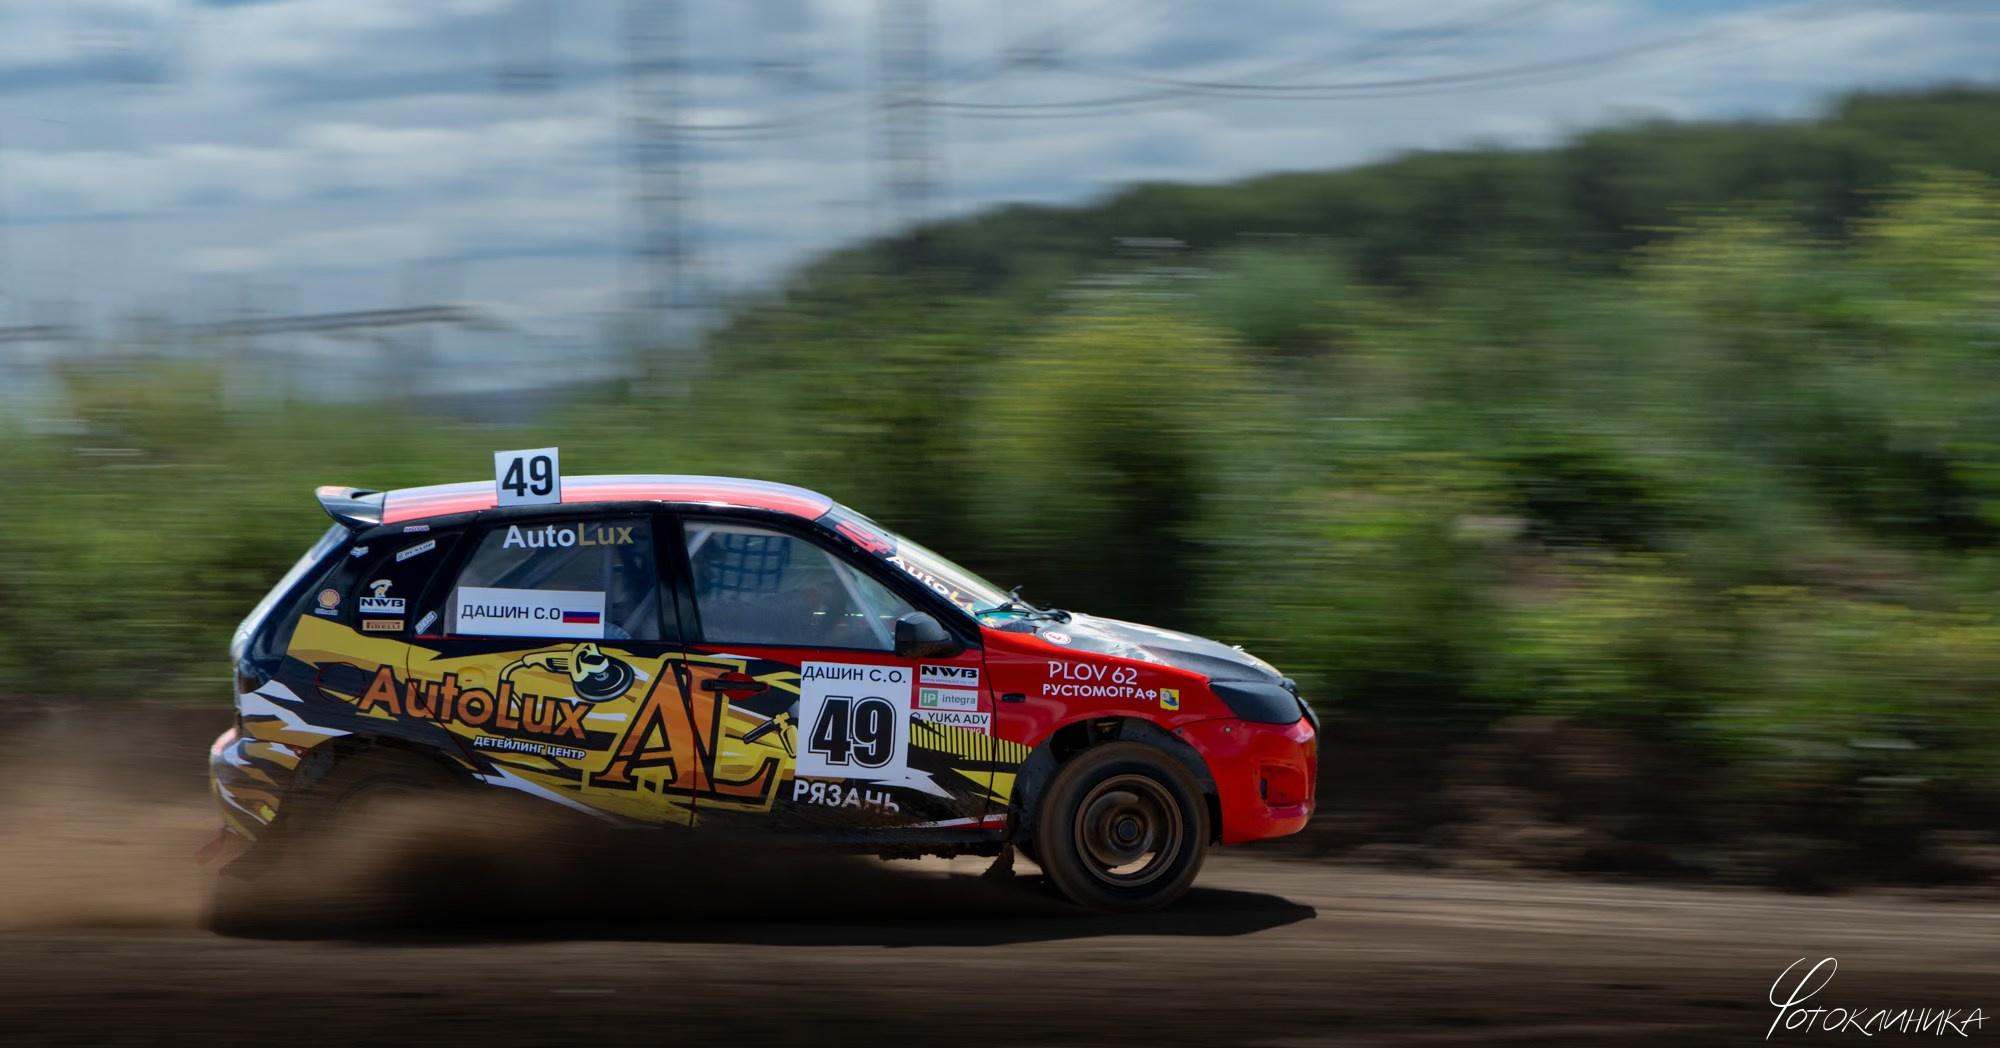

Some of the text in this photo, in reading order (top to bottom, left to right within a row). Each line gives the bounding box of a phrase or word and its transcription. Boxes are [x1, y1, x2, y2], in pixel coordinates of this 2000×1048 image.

[502, 455, 553, 497] 49
[503, 521, 634, 549] AutoLux
[361, 598, 404, 607] NWB
[461, 603, 561, 621] ДАШИН С.О
[366, 621, 401, 630] PIRELLI
[802, 665, 907, 684] ДАШИН С.О.
[921, 665, 978, 678] NWB
[1048, 660, 1137, 684] PLOV 62
[923, 692, 976, 705] IP integra
[1042, 683, 1157, 699] РУСТОМОГРАФ
[358, 665, 592, 741] AutoLux
[928, 712, 989, 724] YUKA ADV
[808, 694, 897, 769] 49
[473, 735, 586, 761] ДЕТЕЙЛИНГ ЦЕНТР
[792, 778, 900, 813] РЯЗАНЬ
